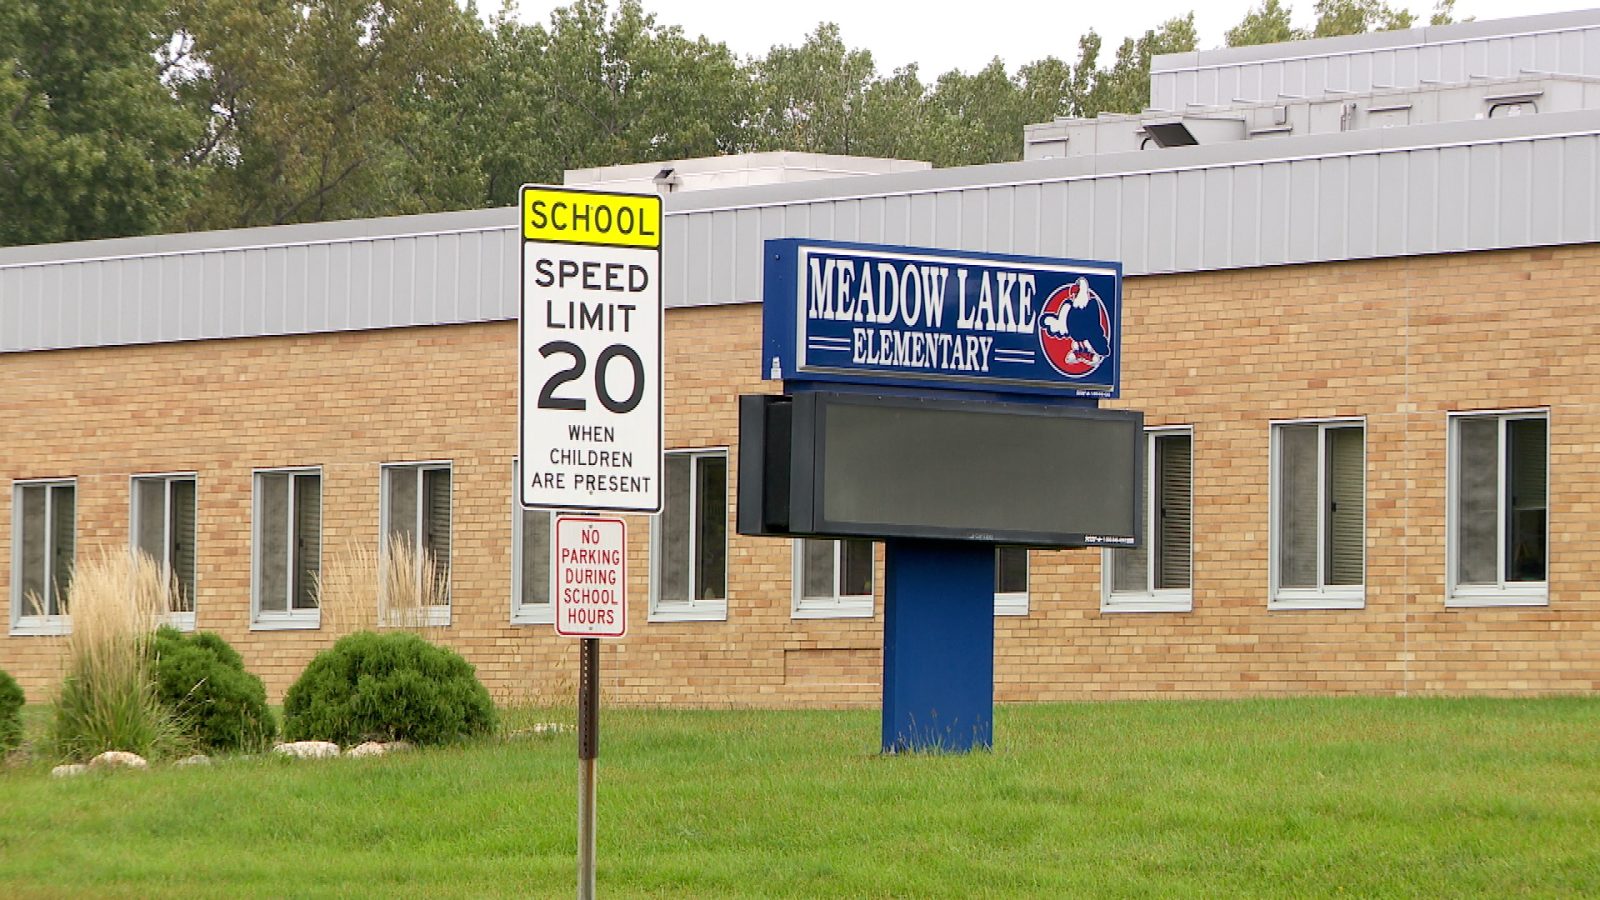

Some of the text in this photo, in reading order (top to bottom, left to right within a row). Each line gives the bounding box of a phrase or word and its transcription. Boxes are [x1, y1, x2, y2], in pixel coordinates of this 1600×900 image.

[531, 200, 655, 236] SCHOOL
[535, 258, 649, 293] SPEED
[808, 257, 1037, 334] MEADOW LAKE
[547, 299, 636, 333] LIMIT
[853, 328, 993, 372] ELEMENTARY
[537, 340, 645, 414] 20
[568, 424, 615, 443] WHEN
[550, 448, 633, 468] CHILDREN
[531, 472, 651, 493] ARE PRESENT
[581, 529, 600, 544] NO
[562, 548, 620, 566] PARKING
[565, 568, 616, 586] DURING
[564, 588, 618, 605] SCHOOL
[568, 608, 614, 625] HOURS
